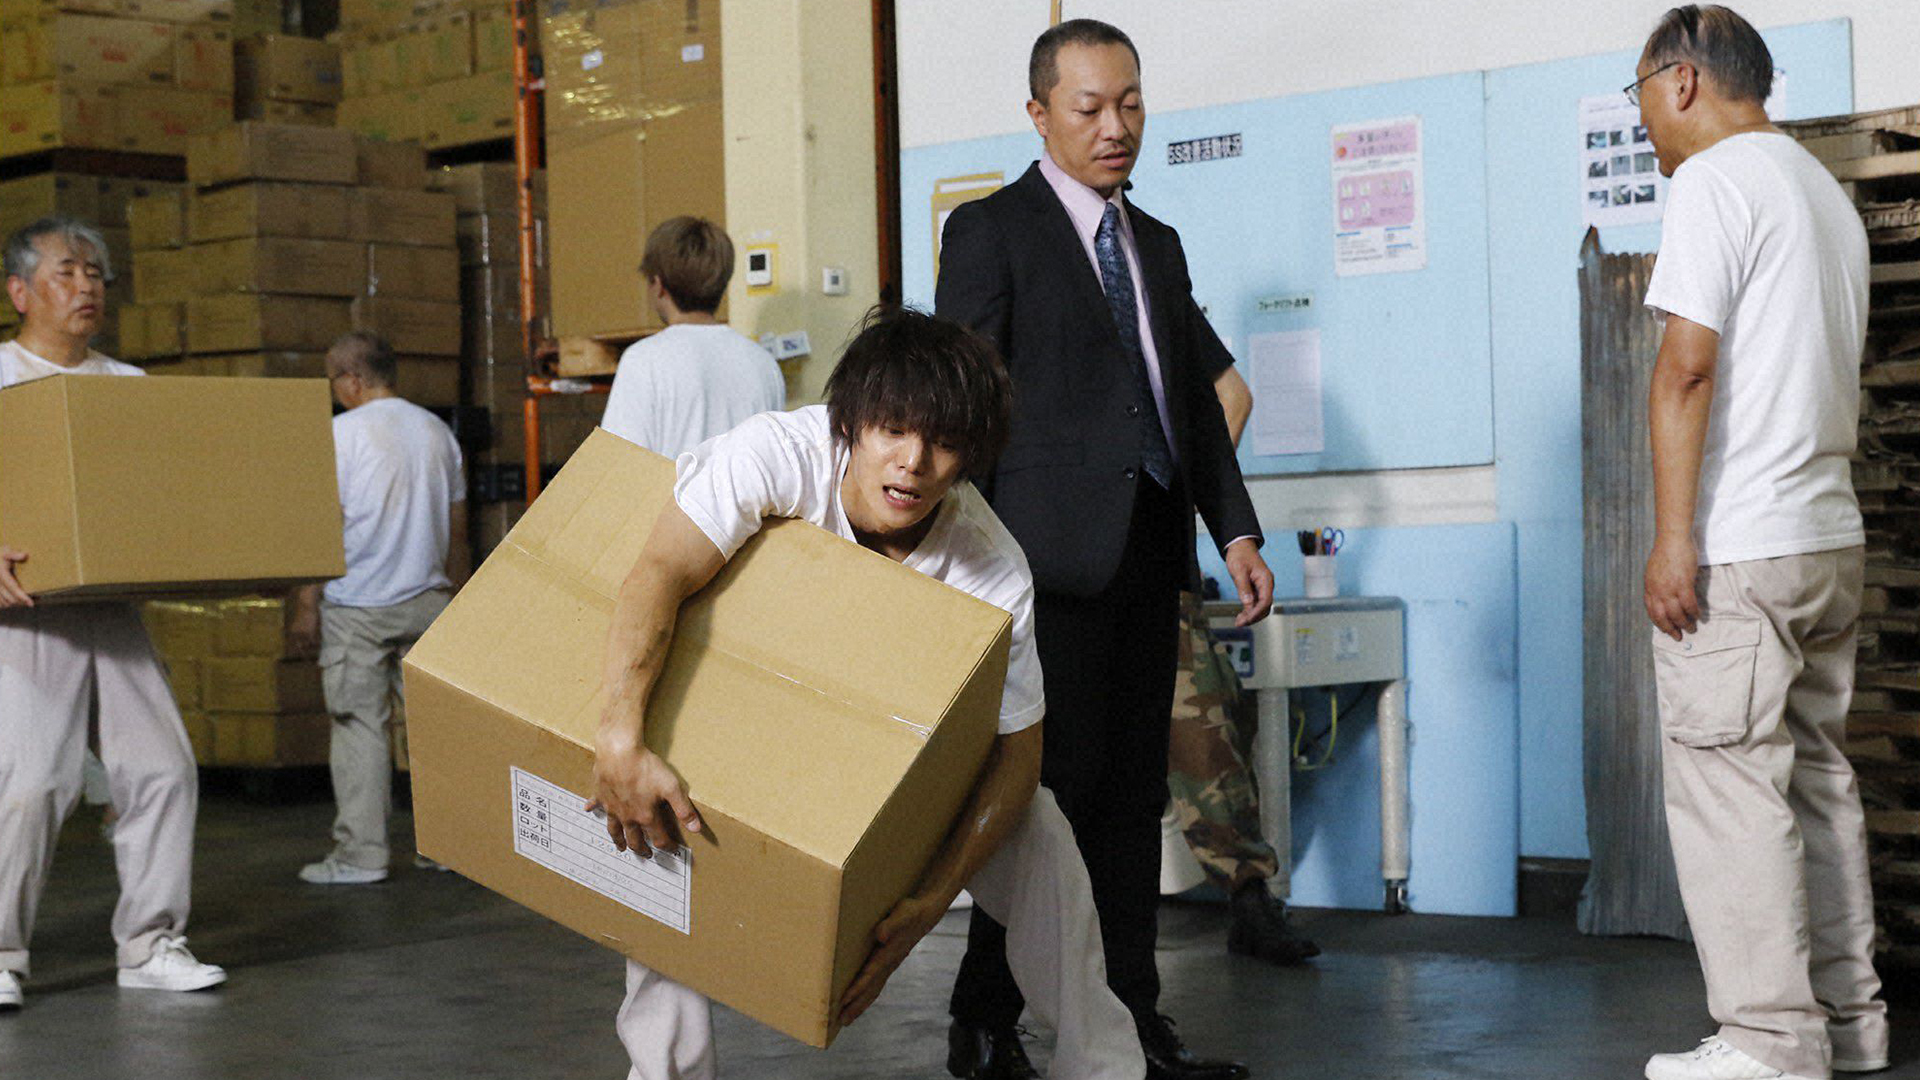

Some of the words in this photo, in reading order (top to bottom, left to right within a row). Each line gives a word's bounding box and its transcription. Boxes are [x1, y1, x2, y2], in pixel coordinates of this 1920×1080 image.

[519, 789, 547, 808] 品名
[520, 802, 547, 821] 数量
[520, 815, 548, 832] ロット
[520, 828, 549, 848] 出荷日
